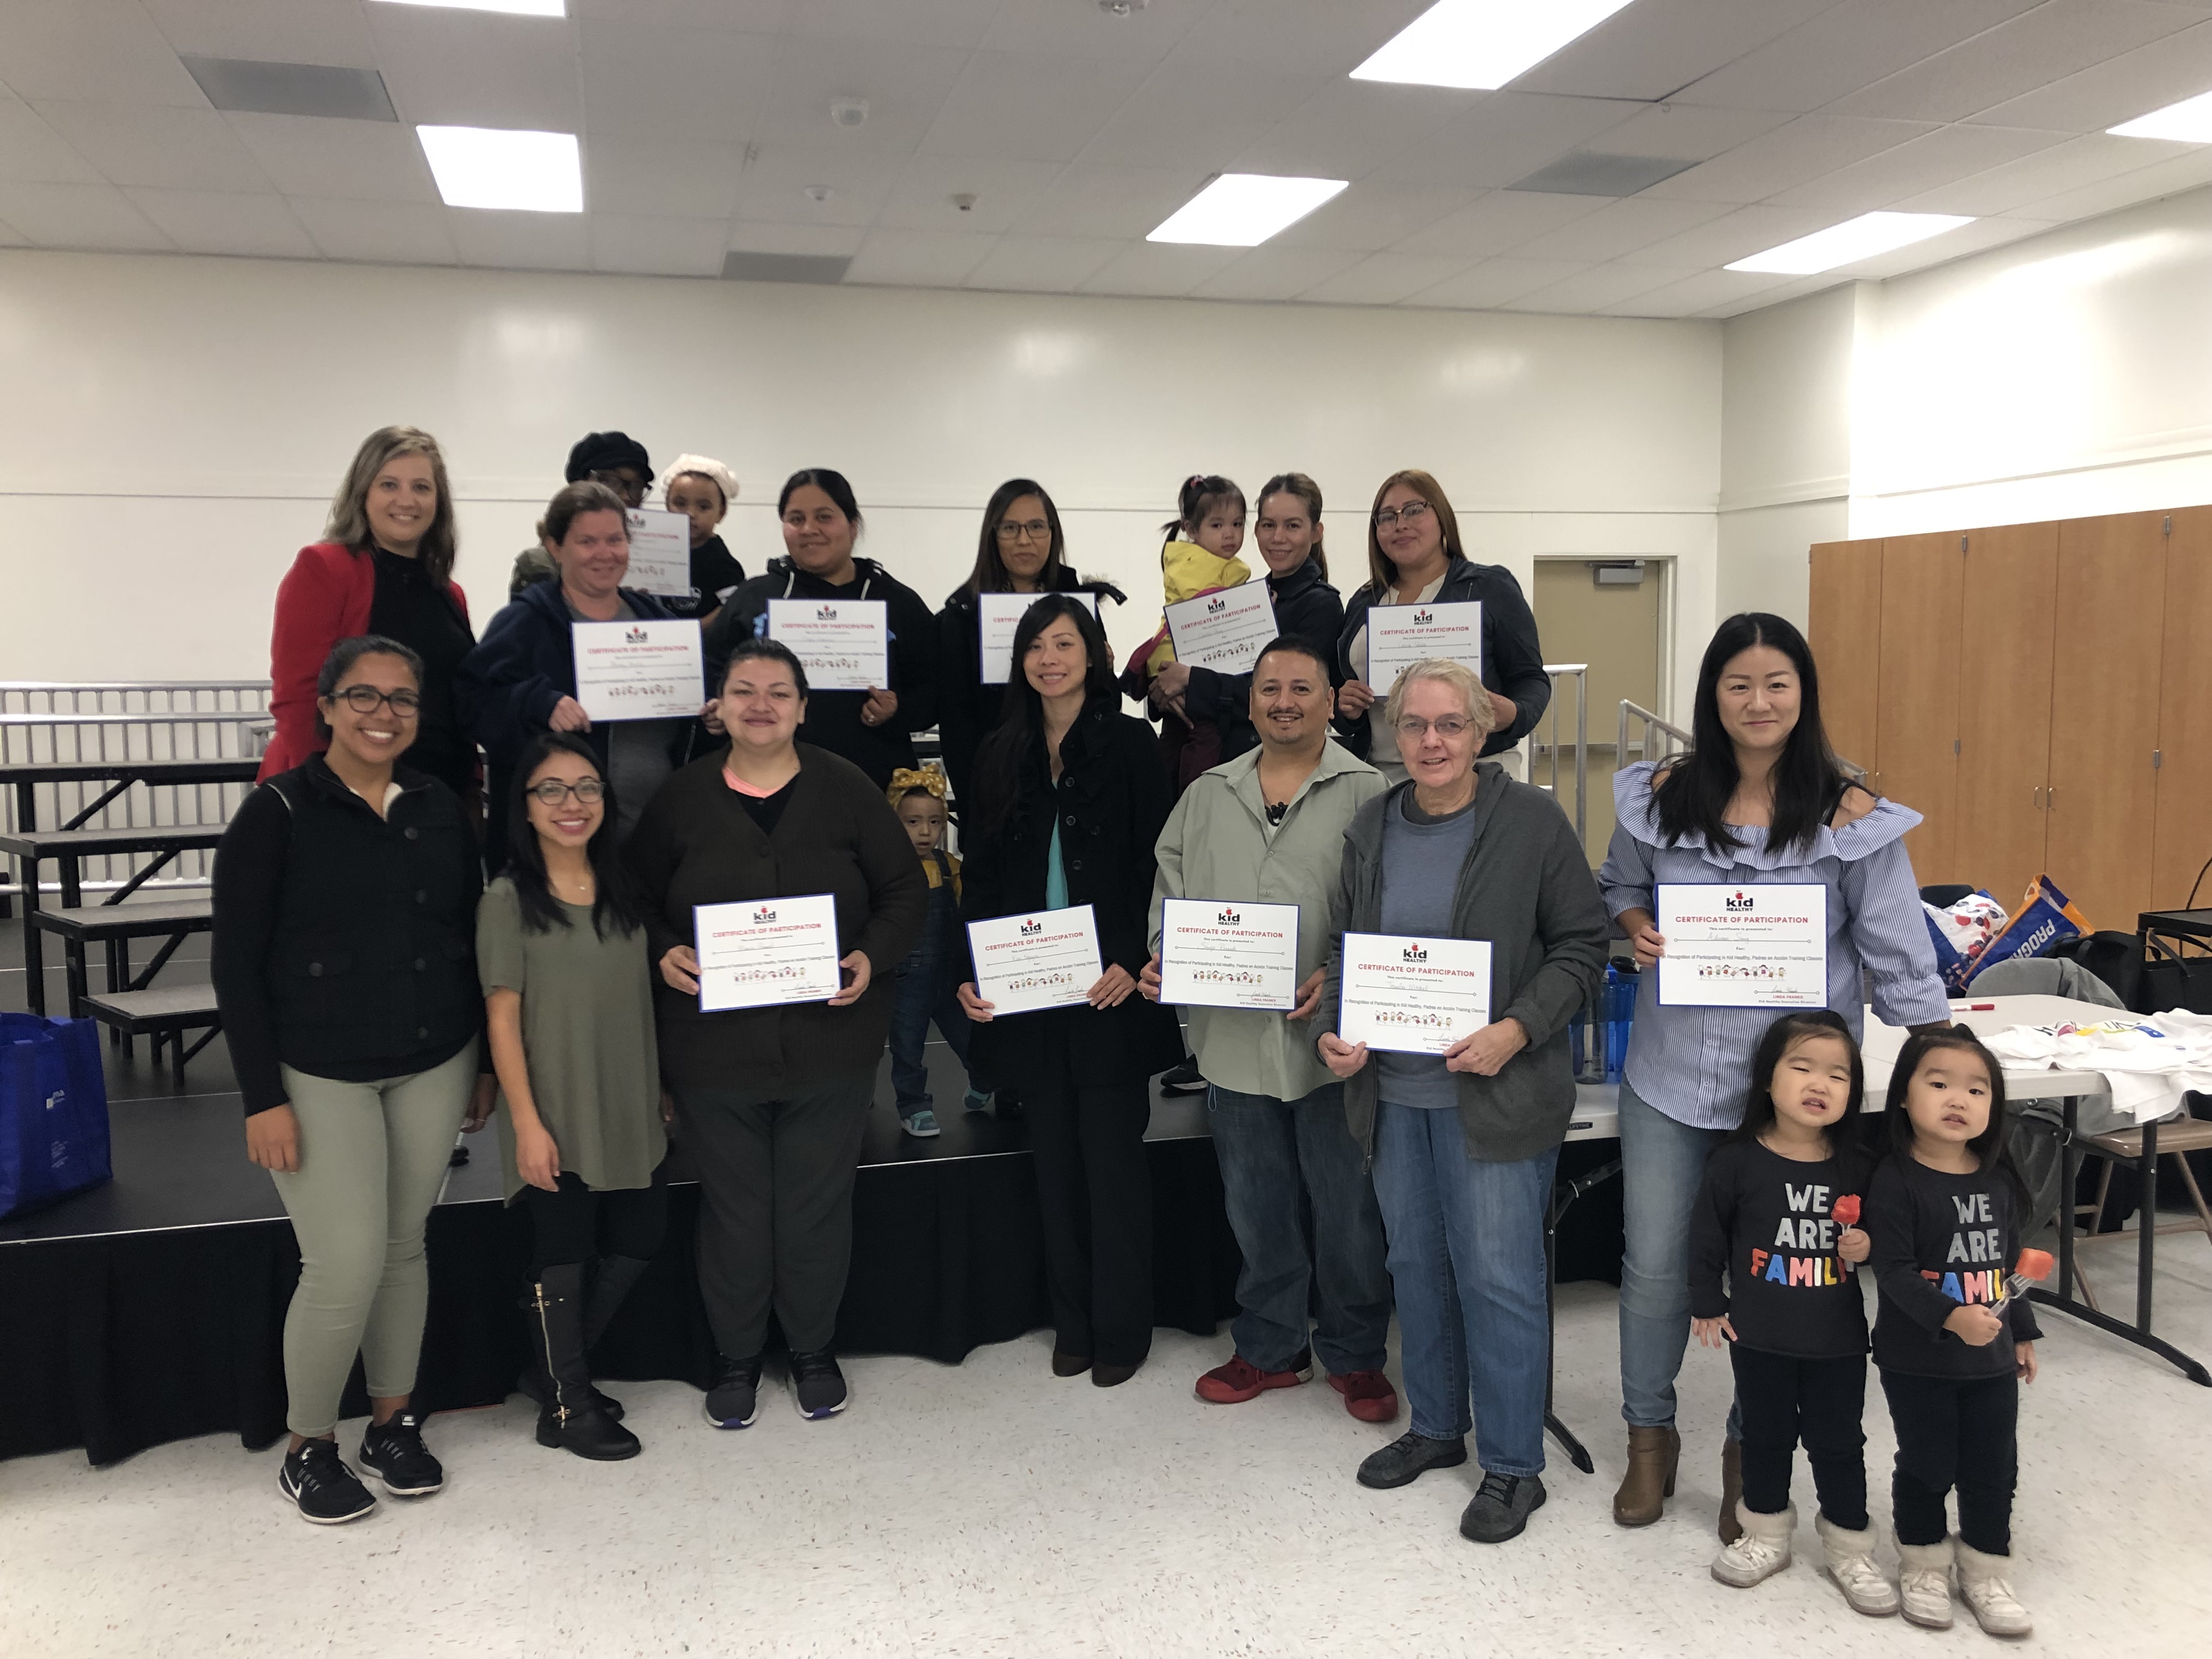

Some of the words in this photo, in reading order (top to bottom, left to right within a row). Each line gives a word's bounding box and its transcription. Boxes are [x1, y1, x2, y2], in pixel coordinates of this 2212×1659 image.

[1207, 600, 1225, 611] kid
[1180, 617, 1212, 630] CERTIFICATE
[1221, 604, 1261, 619] PARTICIPATION
[1726, 898, 1753, 906] kid
[753, 911, 776, 920] kid
[1218, 913, 1240, 922] kid
[712, 929, 756, 938] CERTIFICATE
[769, 923, 821, 933] PARTICIPATION
[1020, 923, 1041, 933] kid
[985, 940, 1024, 951] CERTIFICATE
[1036, 932, 1083, 943] PARTICIPATION
[1403, 949, 1427, 958] kid
[1358, 963, 1403, 972] CERTIFICATE
[1418, 967, 1474, 977] PARTICIPATION
[1785, 1183, 1829, 1213] WE
[1951, 1193, 1993, 1224] WE
[1774, 1217, 1834, 1249] ARE
[1946, 1228, 2001, 1263] ARE
